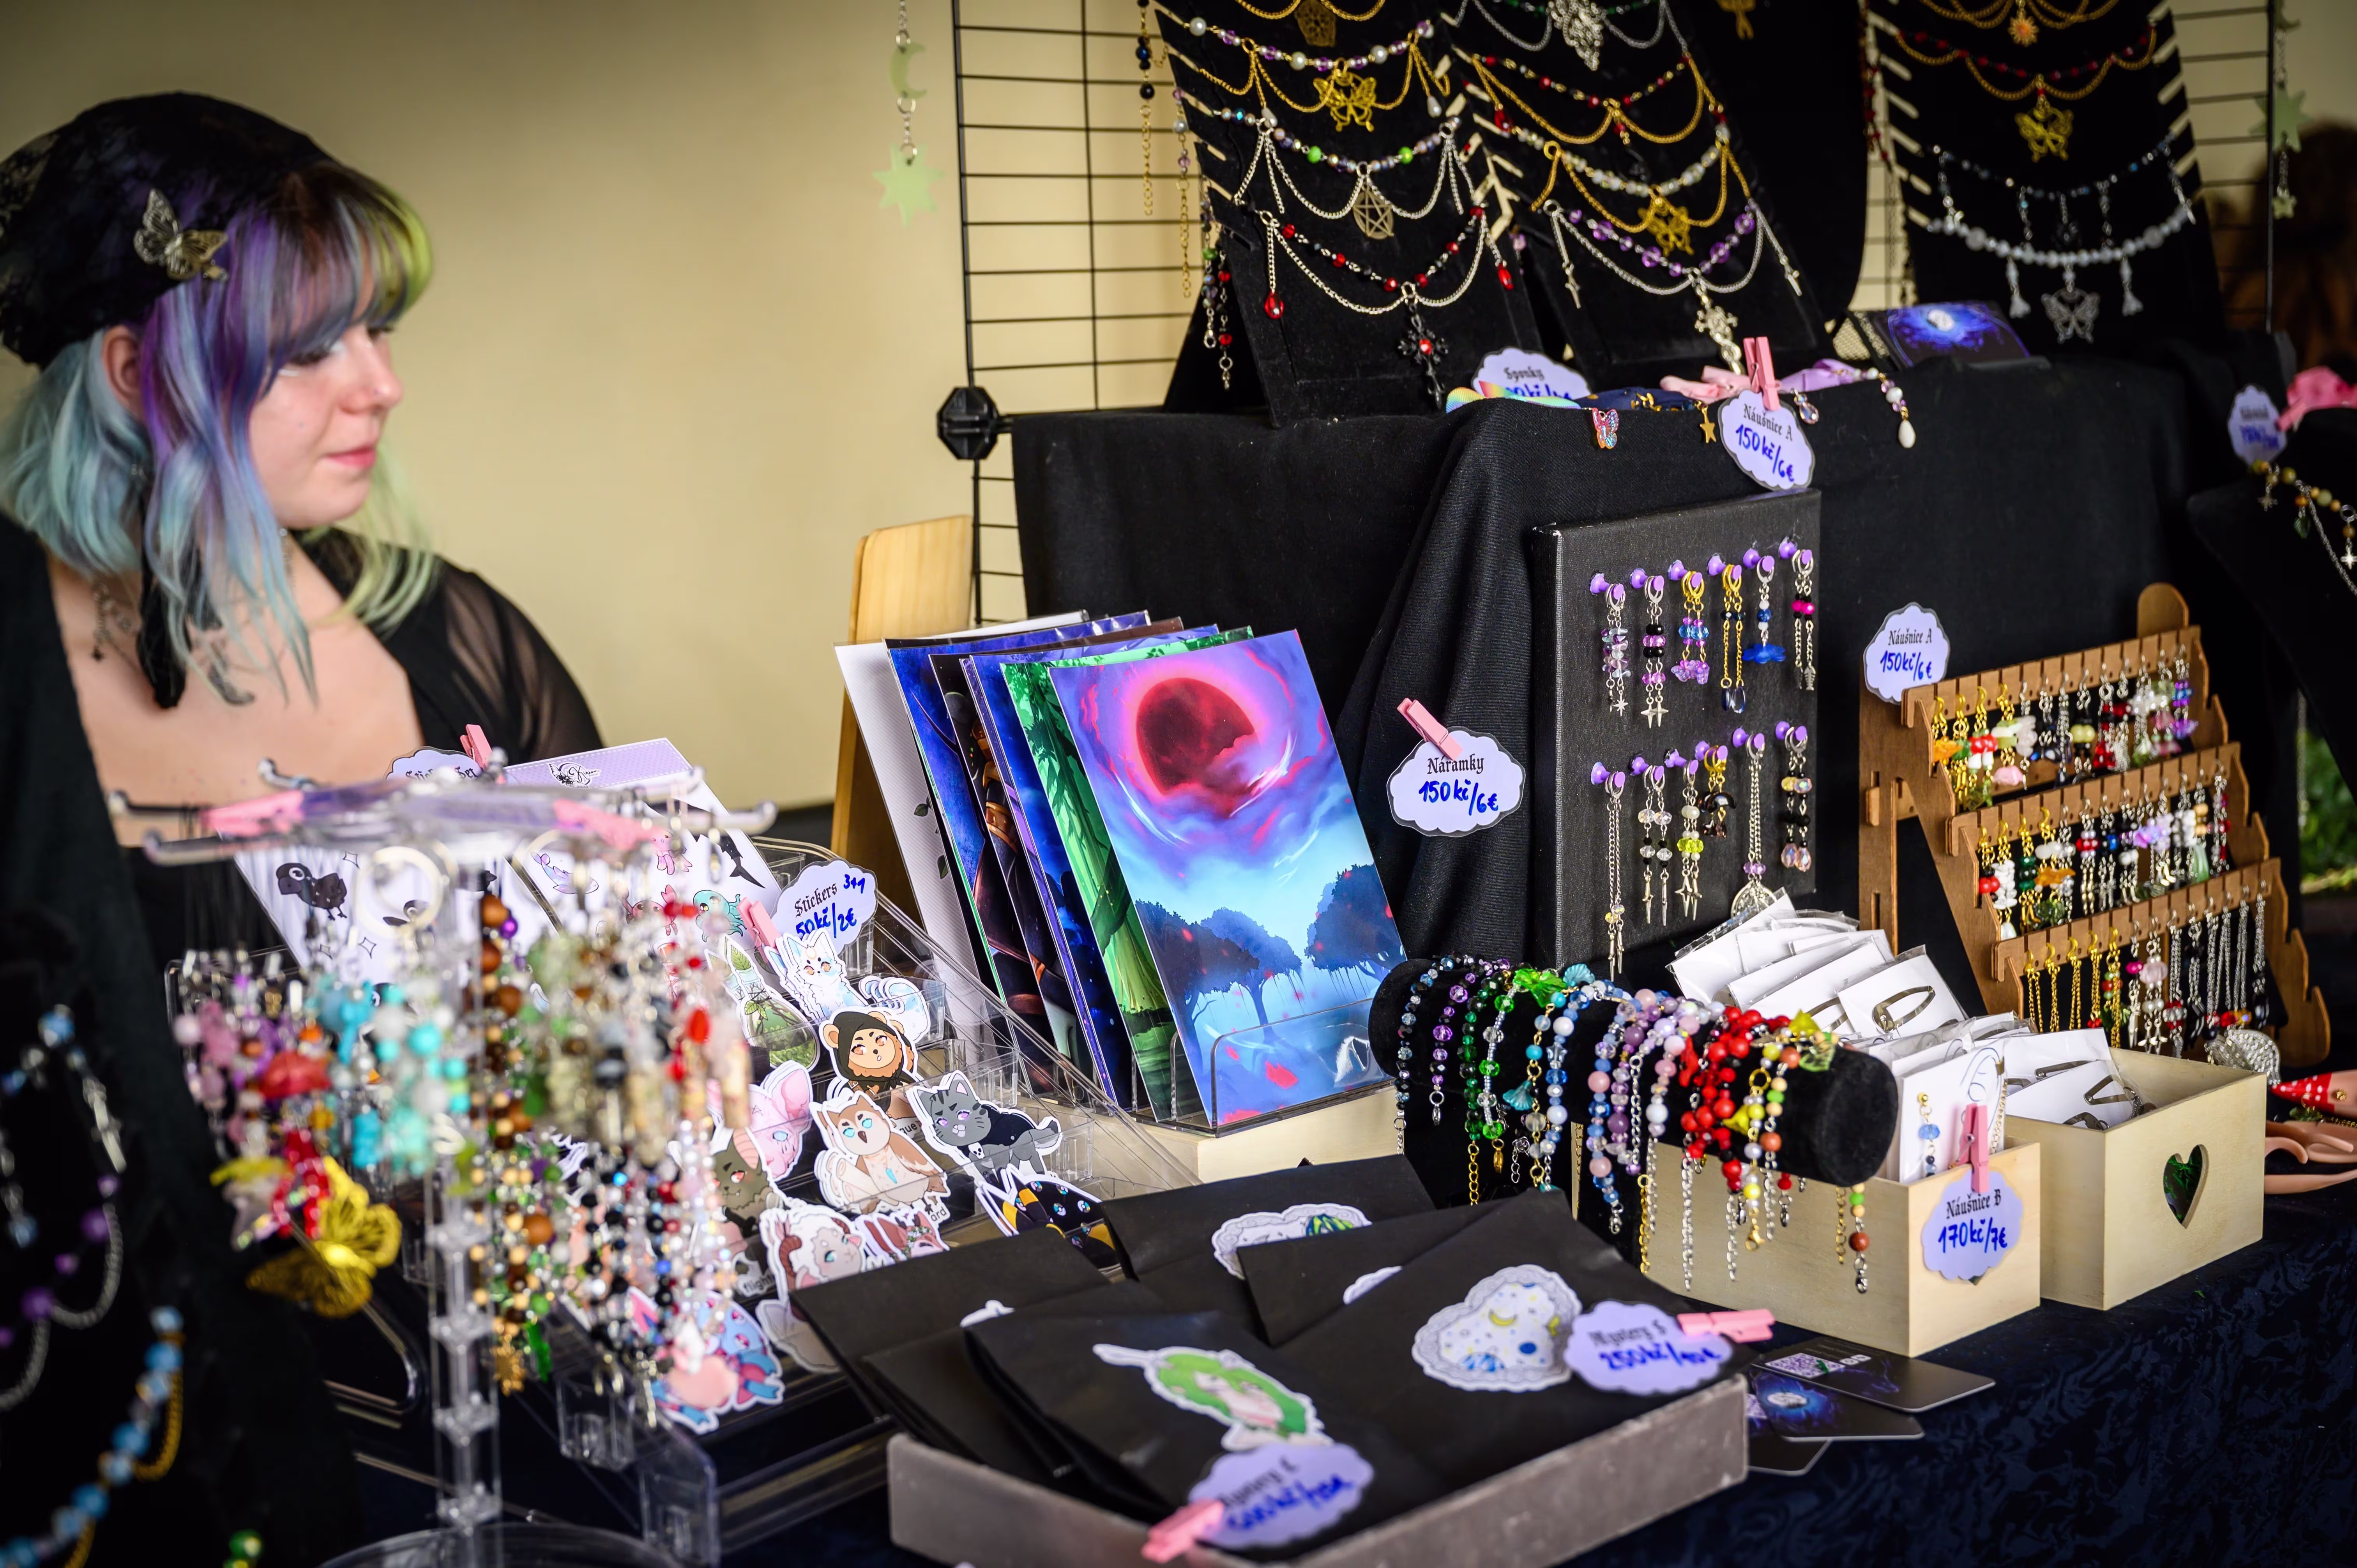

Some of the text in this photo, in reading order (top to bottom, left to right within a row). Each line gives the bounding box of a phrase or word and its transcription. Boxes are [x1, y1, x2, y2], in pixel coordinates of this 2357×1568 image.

[1744, 404, 1793, 441] Náušnice A
[1887, 628, 1932, 646] Náušnice A
[1427, 754, 1484, 774] Náramky
[843, 874, 865, 894] 3+1
[795, 883, 837, 918] Stickers
[931, 1206, 947, 1222] ard
[1946, 1189, 2002, 1219] Náušnice B
